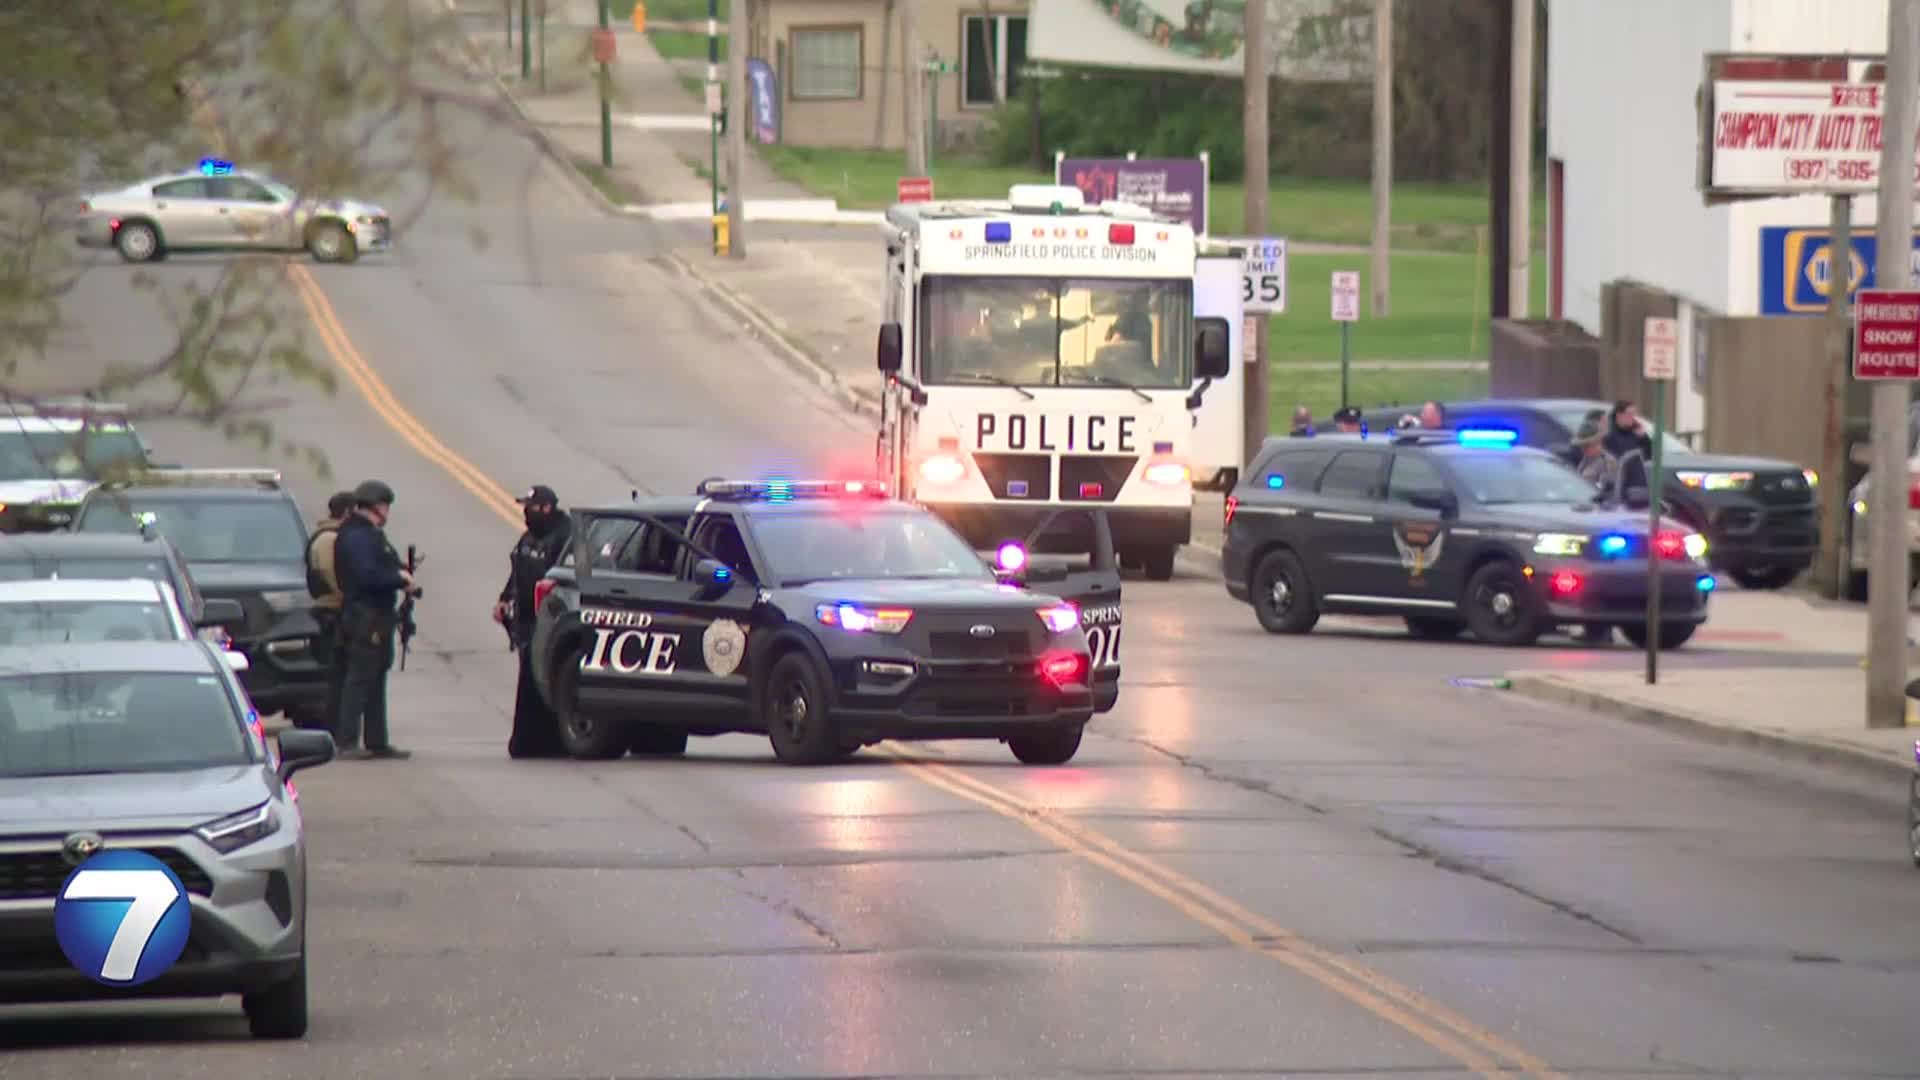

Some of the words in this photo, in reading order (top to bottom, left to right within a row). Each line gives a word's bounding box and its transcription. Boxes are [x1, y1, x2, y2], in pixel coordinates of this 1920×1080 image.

[1716, 112, 1778, 150] CHAMPION
[1779, 113, 1815, 150] CITY
[1815, 114, 1856, 151] AUTO
[965, 245, 1048, 260] SPRINGFIELD
[1053, 245, 1096, 260] POLICE
[1101, 245, 1157, 262] DIVISION
[1241, 246, 1282, 258] EED
[1864, 329, 1914, 345] SNOW
[1859, 351, 1918, 368] ROUTE
[977, 413, 1136, 452] POLICE
[580, 609, 652, 627] GFIELD
[580, 628, 680, 675] ICE
